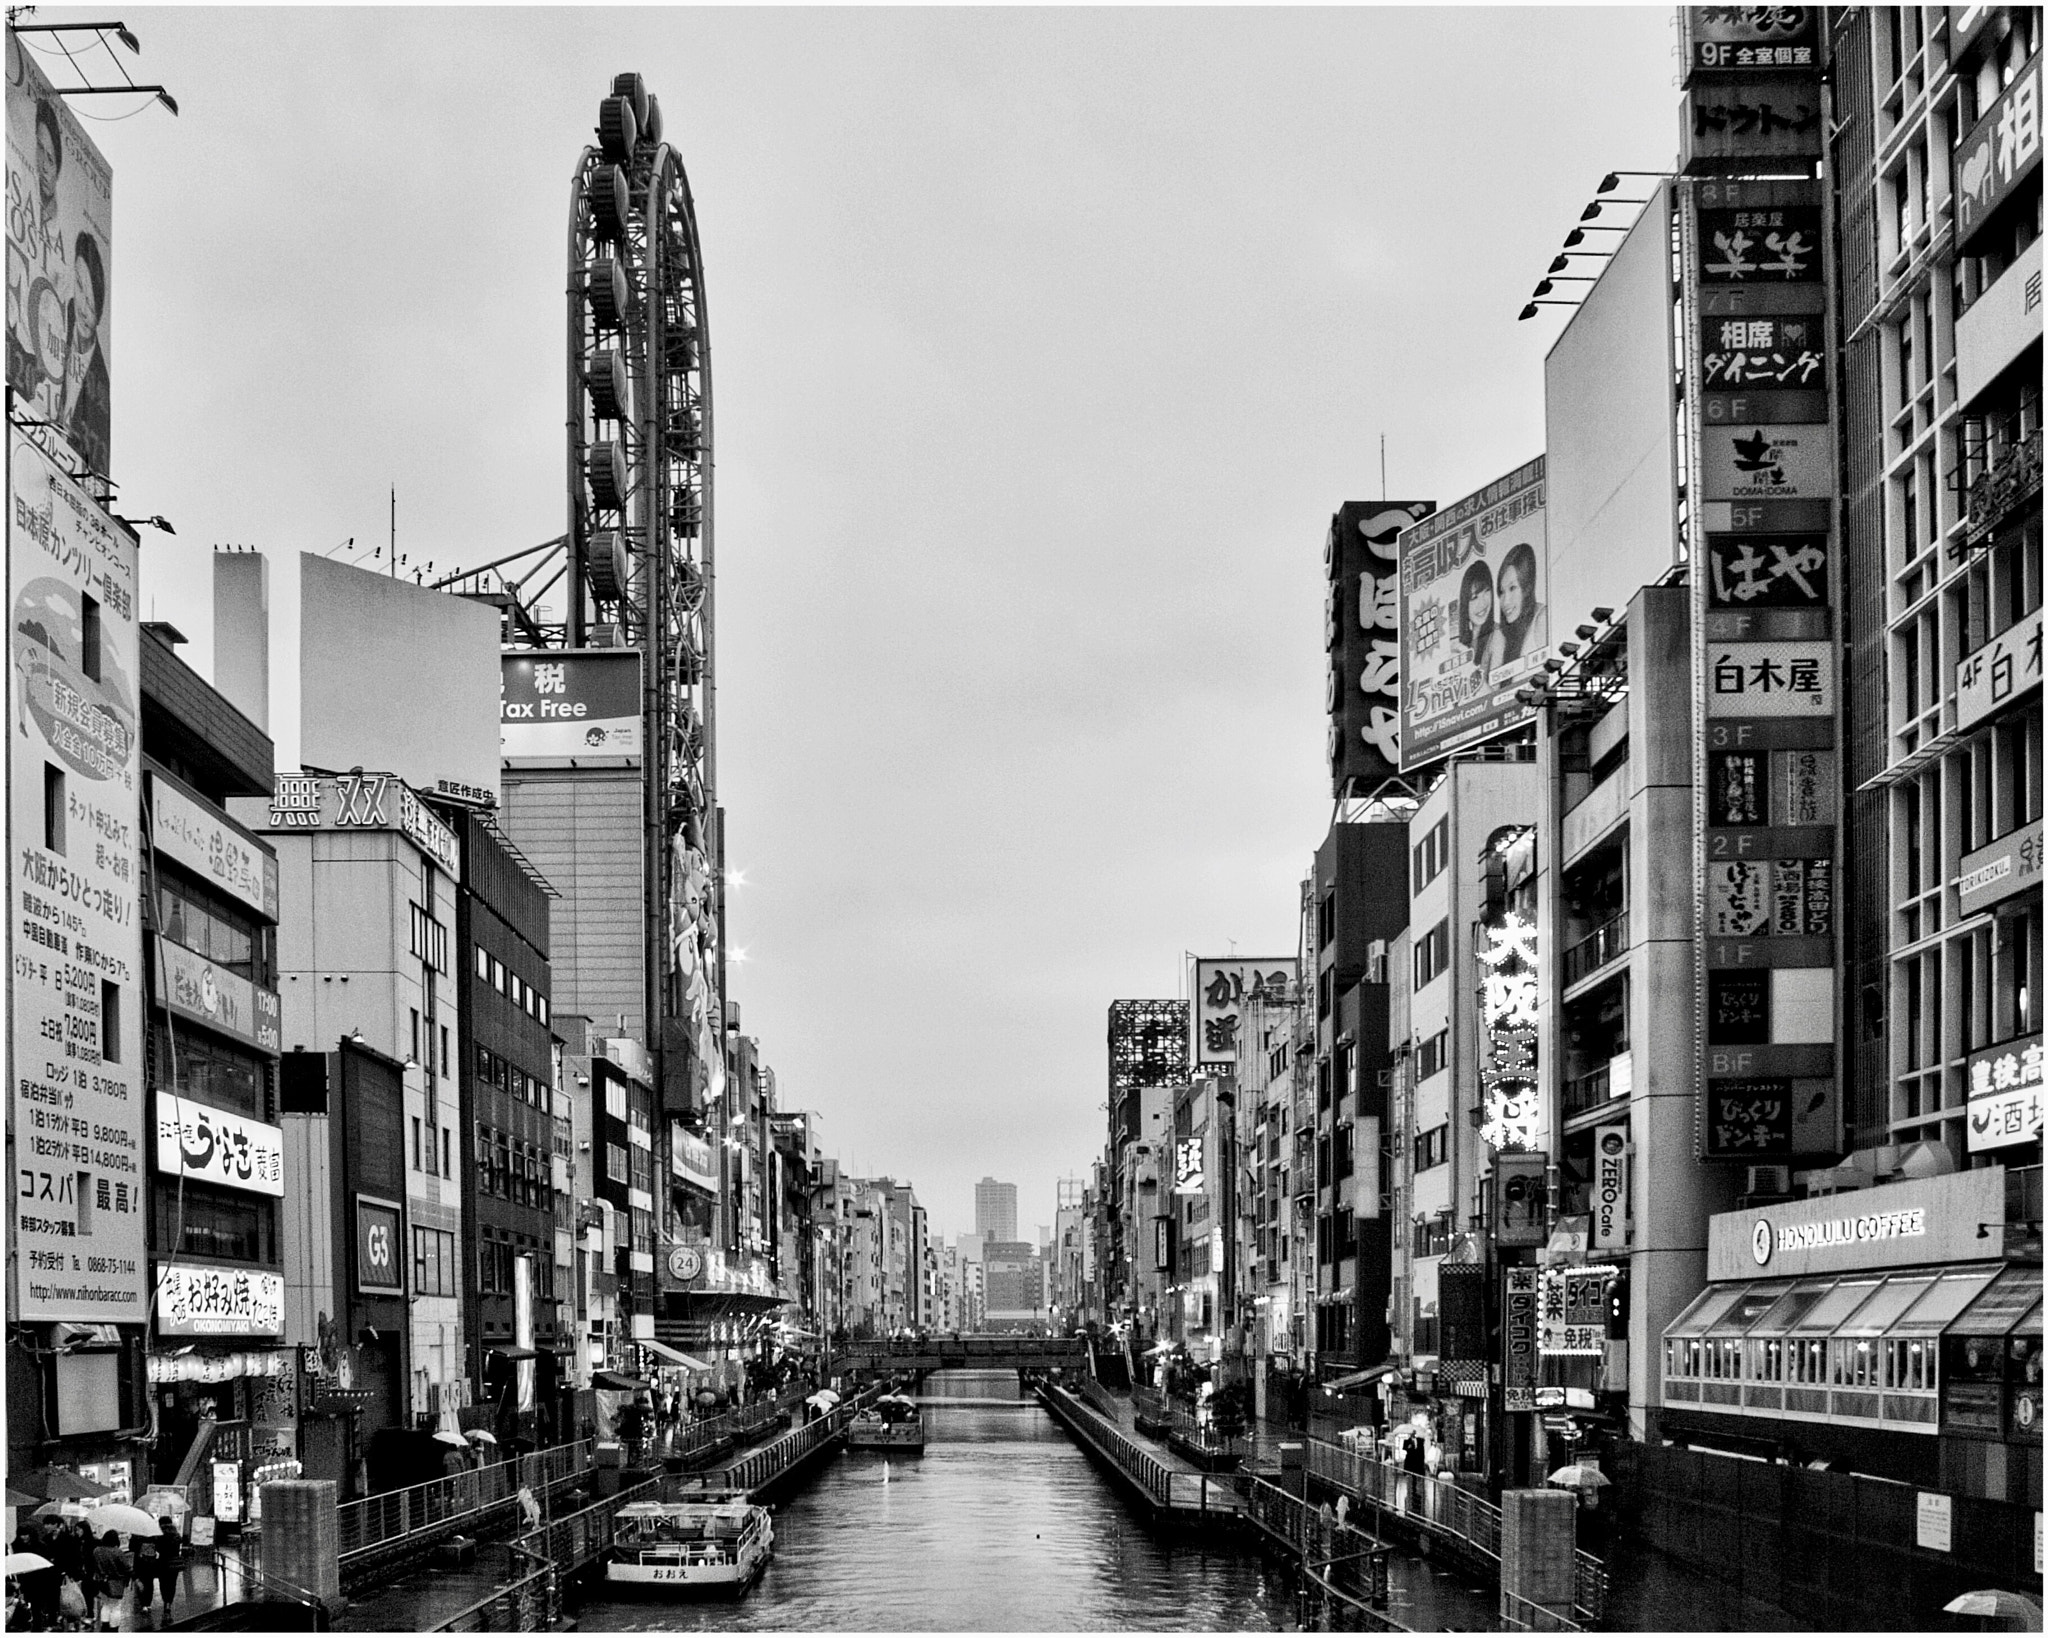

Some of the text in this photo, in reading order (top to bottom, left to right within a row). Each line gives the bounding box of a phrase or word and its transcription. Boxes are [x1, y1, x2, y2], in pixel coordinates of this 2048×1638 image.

[1702, 43, 1812, 66] 9F 全室個室
[1997, 68, 2043, 184] 相
[1702, 185, 1740, 201] 8F
[5, 164, 66, 264] SAKA
[1705, 231, 1813, 279] 笑笑
[1705, 290, 1744, 310] 7F
[1721, 321, 1773, 349] 相席
[1703, 352, 1824, 384] ダイニング
[1708, 399, 1746, 418] 6F
[1480, 482, 1546, 538] お仕事探し
[1732, 508, 1762, 527] 5F
[1412, 519, 1486, 592] 高収入
[1711, 545, 1825, 602] はや
[1712, 617, 1750, 636] 4F
[1715, 655, 1822, 693] 白木屋
[1962, 656, 1983, 689] 4F
[541, 700, 587, 717] Free
[1713, 726, 1752, 745] 3F
[437, 779, 496, 800] 意匠作成中
[1713, 835, 1752, 854] 2F
[1814, 860, 1830, 868] 2F
[22, 848, 131, 926] 大阪からひとっ走り!
[1716, 945, 1752, 964] 1F
[64, 963, 96, 995] 5,200円
[1721, 992, 1759, 1007] びっくり
[1718, 1009, 1761, 1024] ドンキー
[64, 1013, 97, 1046] 7,800円
[1475, 911, 1539, 1152] 大阪王将
[46, 1062, 127, 1100] ロッジ 1泊 3,780円
[1720, 1099, 1781, 1123] びっくり
[71, 1118, 88, 1139] 平日
[1716, 1124, 1785, 1147] ドンキー
[72, 1144, 89, 1164] 平日
[180, 1112, 252, 1181] うなぎ
[21, 1169, 138, 1213] コスパ 最高!
[1602, 1158, 1618, 1205] ZERO
[21, 1215, 76, 1237] 幹部スタッフ募集
[1777, 1209, 1924, 1250] HONOLULU COFFEE
[368, 1224, 389, 1267] G3
[29, 1250, 64, 1272] 予約受付
[87, 1256, 136, 1275] 0868-75-1144
[676, 1257, 693, 1269] 24
[29, 1282, 138, 1303] http://www.nihonbaracc.com
[189, 1273, 250, 1317] お好み焼
[1568, 1280, 1604, 1307] ダイコ
[194, 1320, 250, 1332] OKONOMIYAKI
[1511, 1296, 1532, 1354] ダイコク
[1564, 1328, 1592, 1349] 免税
